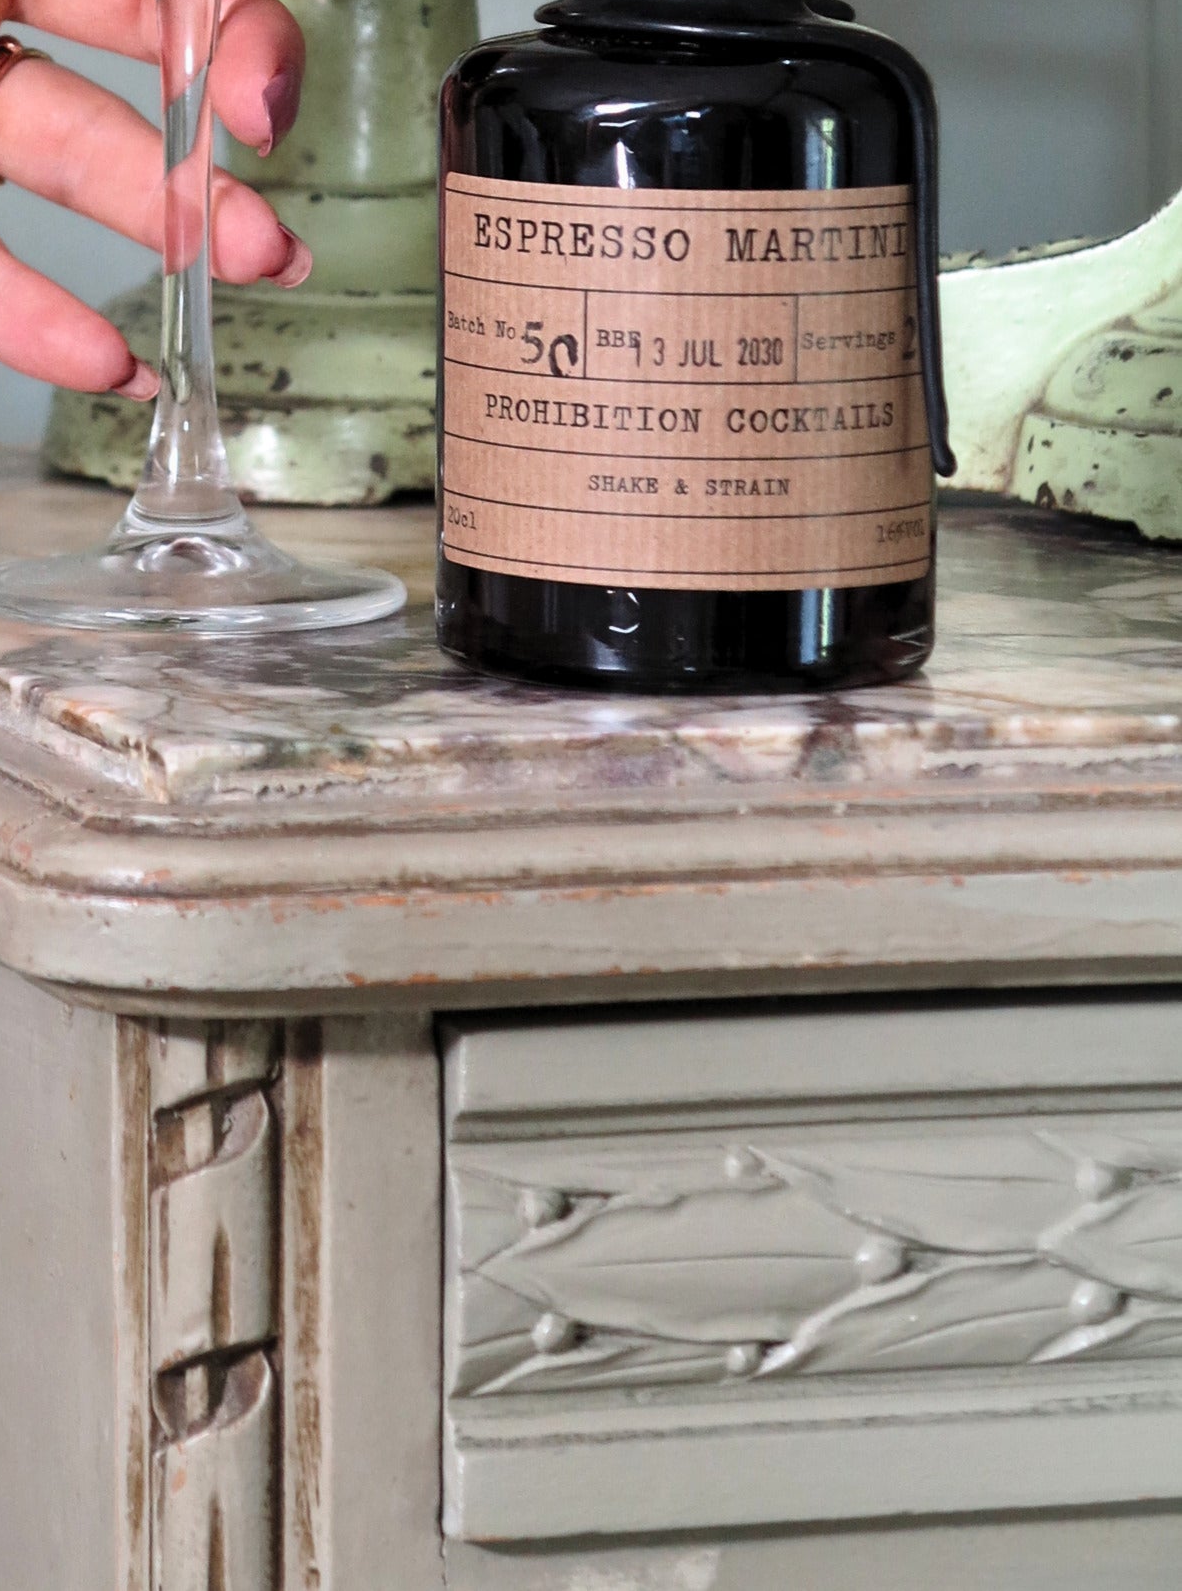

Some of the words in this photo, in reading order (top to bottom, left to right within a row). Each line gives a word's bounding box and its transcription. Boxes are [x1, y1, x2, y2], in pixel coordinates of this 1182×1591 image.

[474, 213, 691, 263] ESPRESSO
[725, 222, 908, 263] MARTINI
[447, 310, 486, 336] Batch
[495, 320, 516, 340] No
[678, 339, 722, 367] JUL
[737, 337, 784, 366] 2030
[801, 331, 897, 351] Servings
[485, 393, 701, 433] PROHIBITION
[727, 402, 895, 434] COCKTAILS
[588, 474, 659, 495] SHAKE
[674, 477, 689, 496] &
[705, 477, 791, 497] STRAIN
